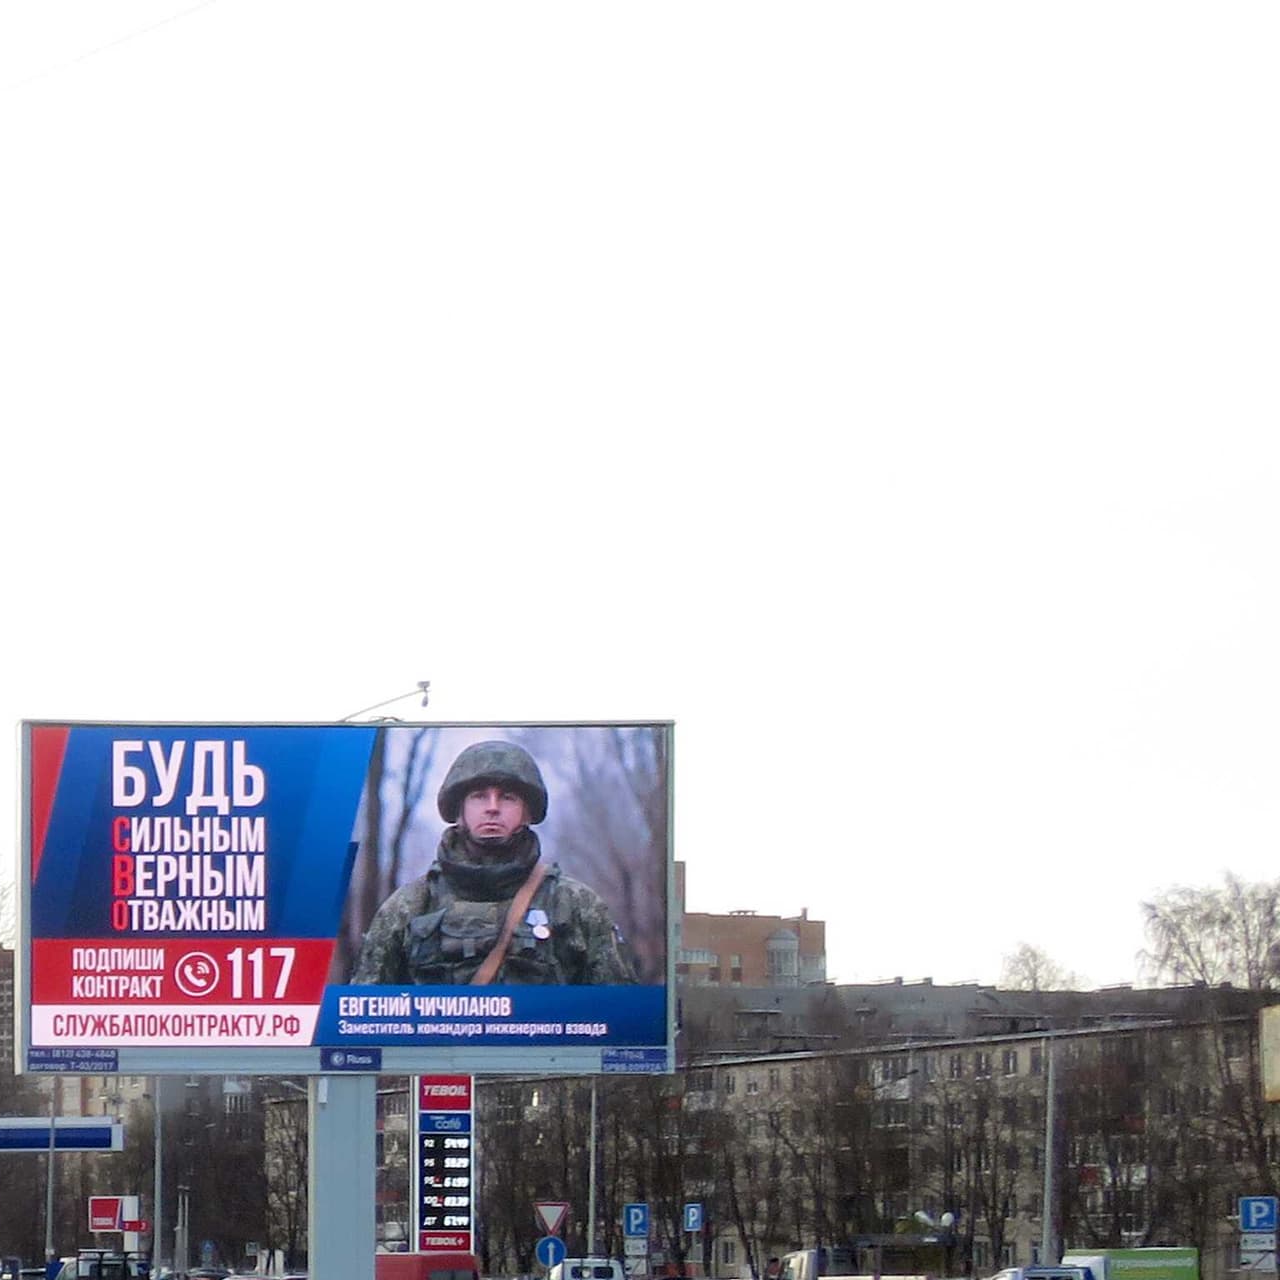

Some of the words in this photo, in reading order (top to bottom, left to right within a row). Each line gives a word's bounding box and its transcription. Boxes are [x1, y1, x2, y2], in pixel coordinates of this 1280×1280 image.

[112, 740, 265, 815] БУДЬ
[112, 816, 265, 852] СИЛЬНЫМ
[112, 855, 265, 897] ВЕРНЫМ
[112, 900, 265, 931] ОТВАЖНЫМ
[72, 948, 164, 972] ПОДПИШИ
[227, 947, 296, 999] 117
[72, 975, 163, 998] КОНТРАКТ
[338, 992, 410, 1017] ЕВГЕНИЙ
[414, 996, 512, 1017] ЧИЧИЛАНОВ
[52, 1013, 301, 1038] СЛУЖБАПОКОНТРАКТУ.РФ
[338, 1020, 414, 1035] Заместитель
[417, 1023, 482, 1036] командира
[485, 1023, 562, 1036] инженерного
[565, 1023, 607, 1036] взвода
[423, 1084, 468, 1096] TEBOIL
